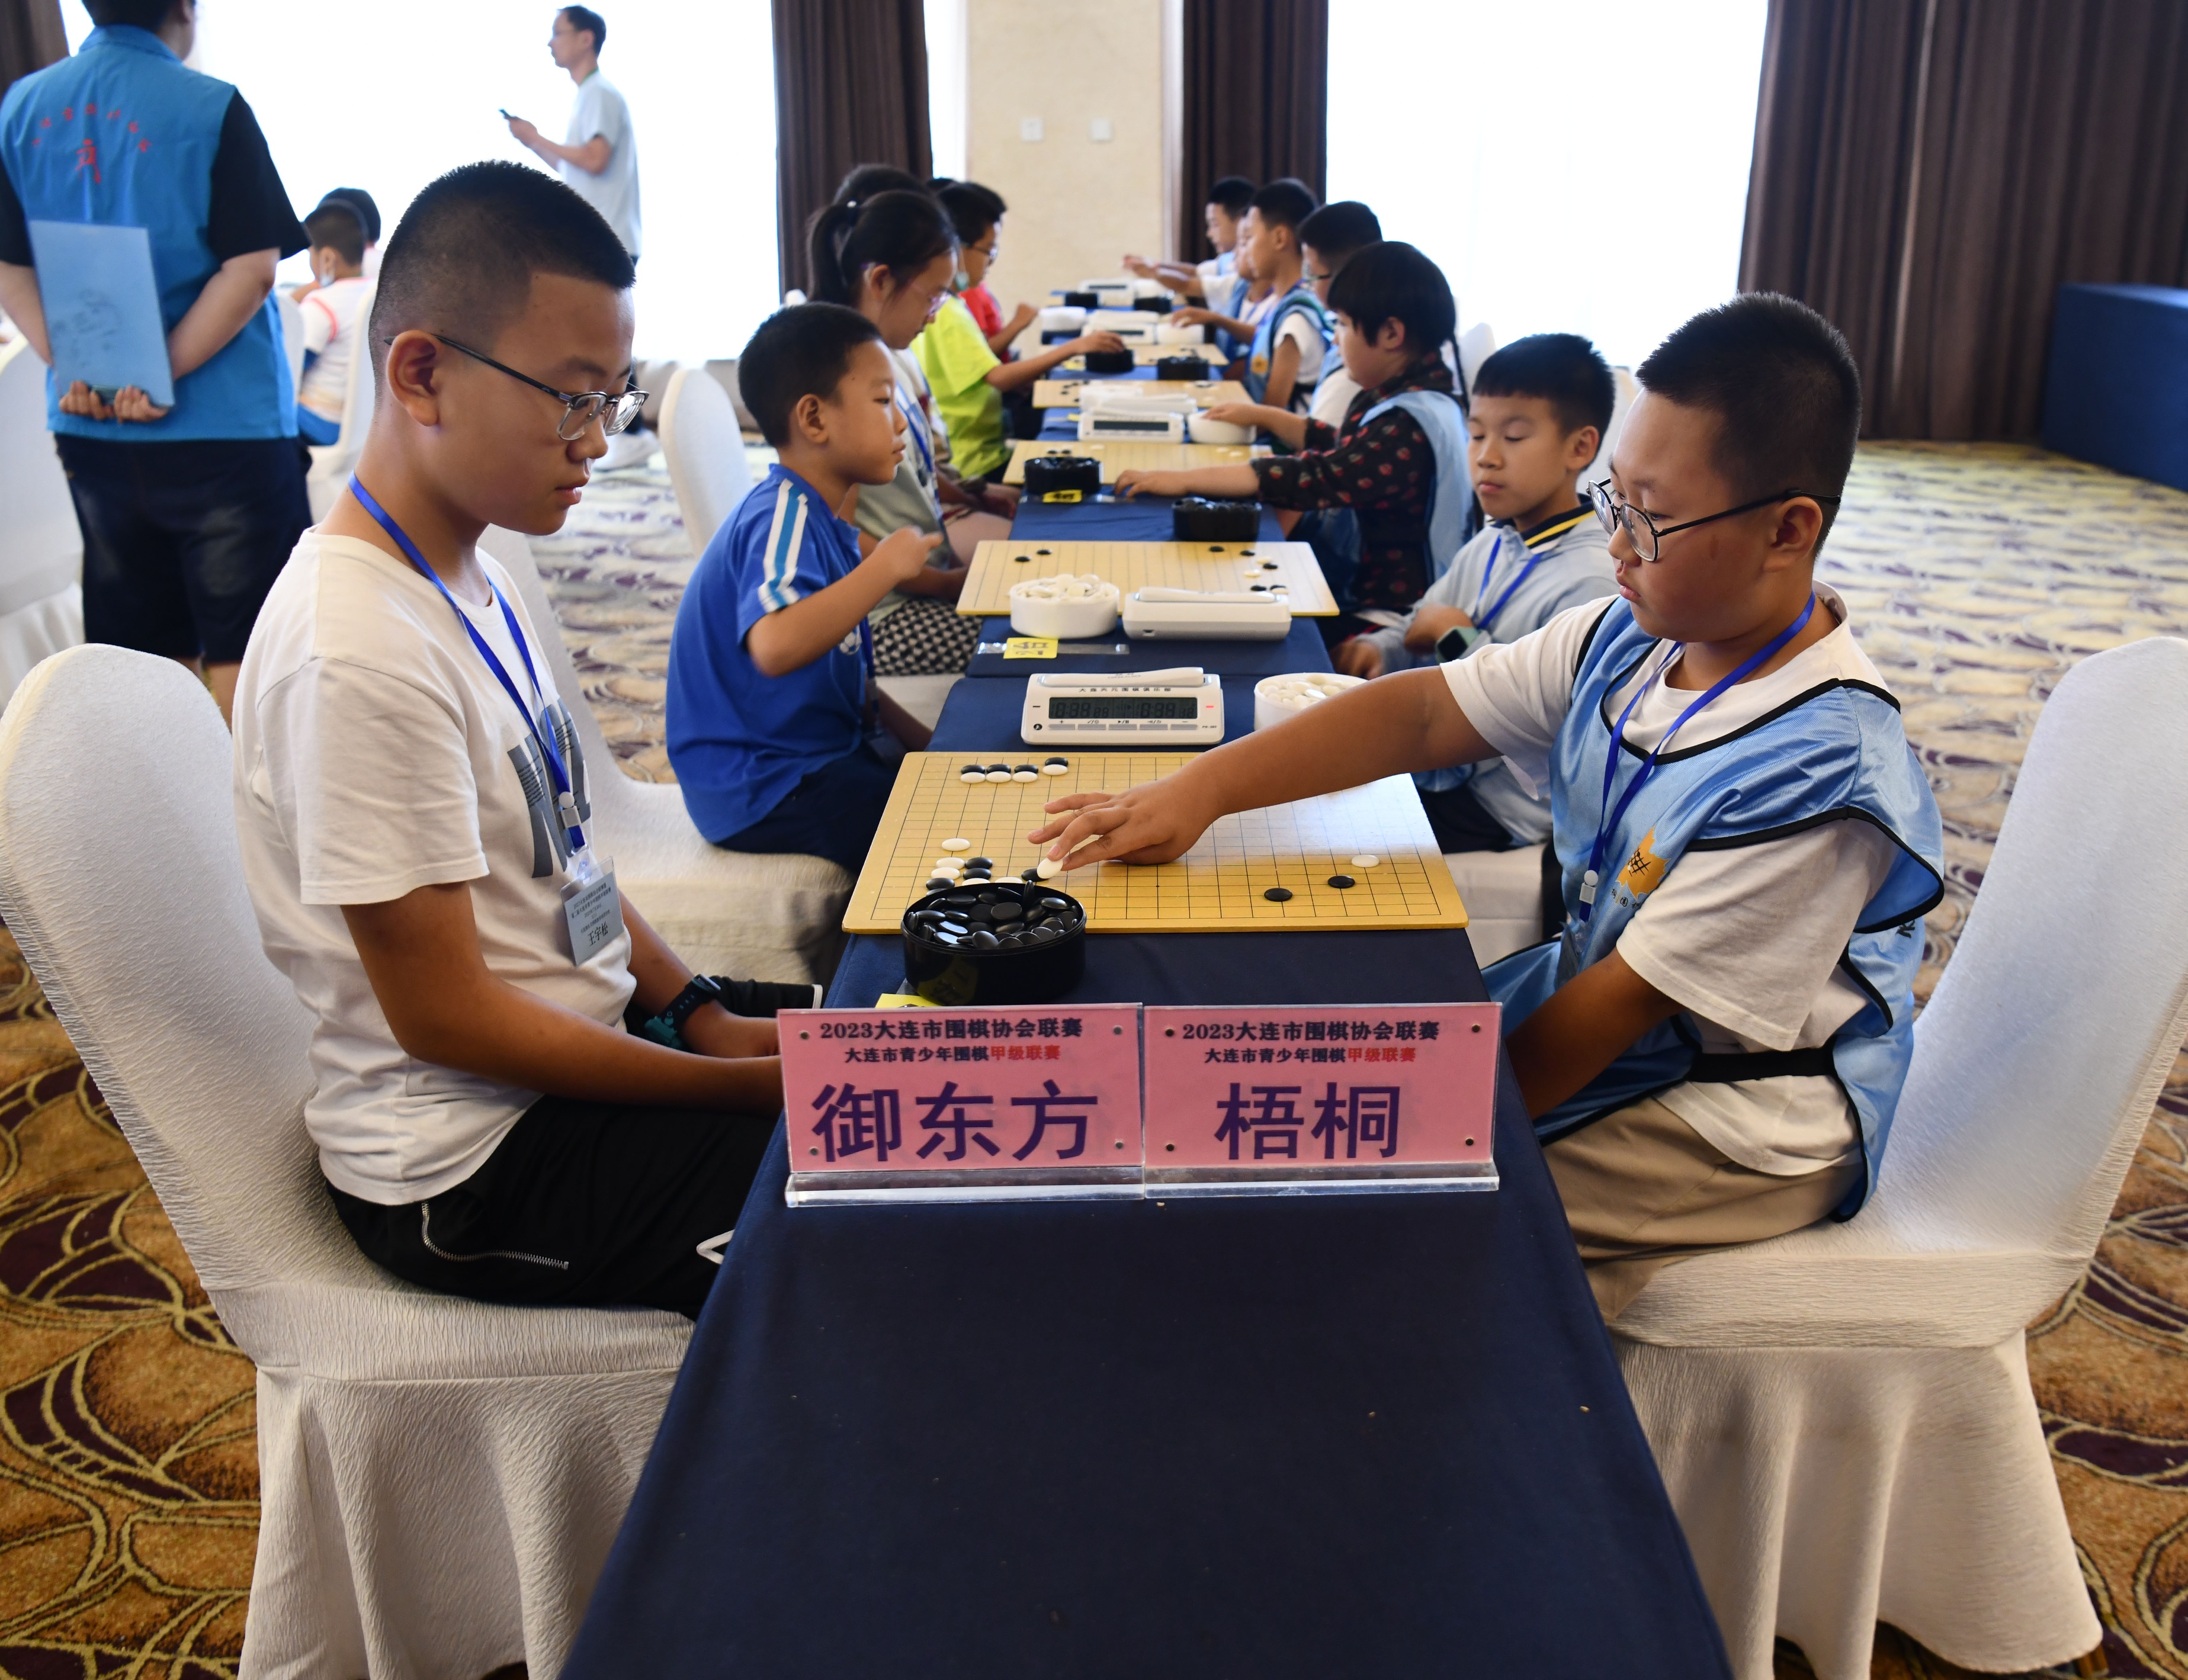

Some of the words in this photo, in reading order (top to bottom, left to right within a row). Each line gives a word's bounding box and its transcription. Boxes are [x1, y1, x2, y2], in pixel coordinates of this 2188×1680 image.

[820, 1018, 1083, 1040] 2023大连市围棋协会联赛
[1182, 1021, 1439, 1041] 2023大连市围棋协会联赛
[811, 1079, 1099, 1162] 御东方
[1214, 1082, 1401, 1160] 梧桐
